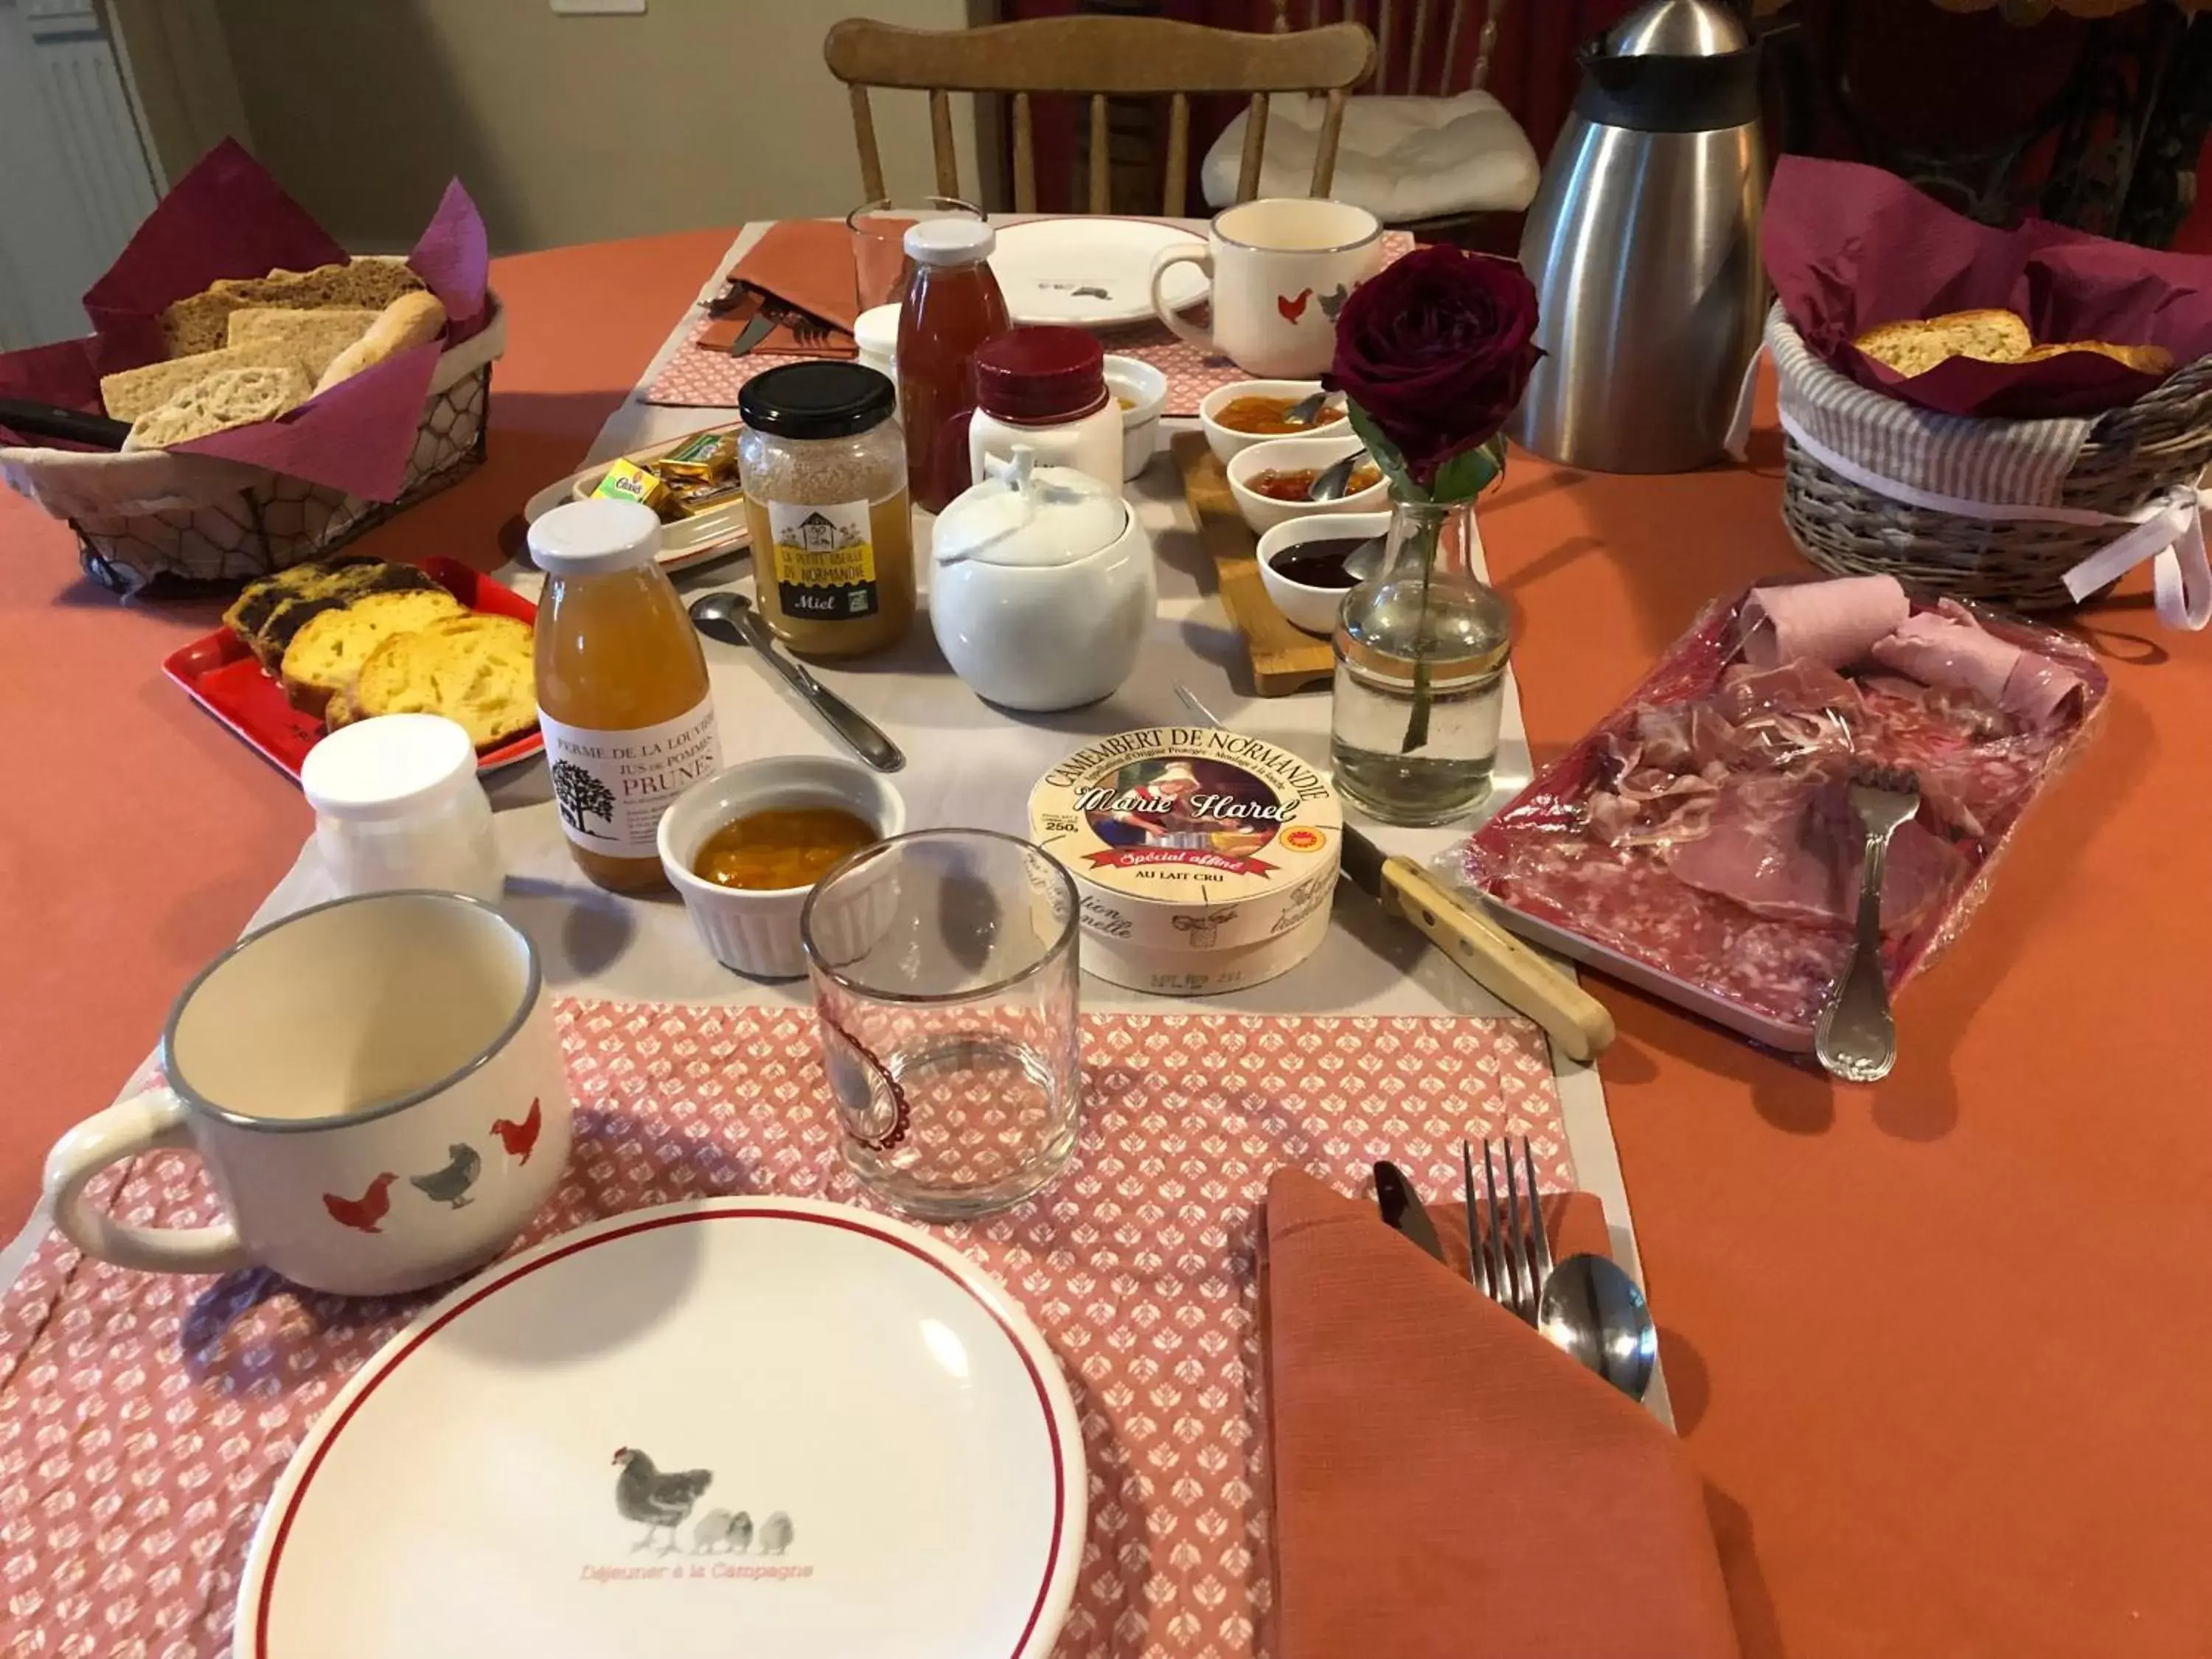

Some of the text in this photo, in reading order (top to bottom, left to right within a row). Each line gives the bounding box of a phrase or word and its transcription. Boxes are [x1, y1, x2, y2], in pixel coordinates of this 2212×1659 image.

[801, 566, 864, 582] NORMANDIE
[794, 595, 836, 611] Miel
[557, 738, 604, 759] FERME
[613, 748, 636, 759] DE
[642, 743, 661, 757] LA
[1045, 729, 1329, 801] CAMEMBERT DE NORMANDIE
[1074, 784, 1301, 824] Marie Harel
[1119, 852, 1245, 870] Spécial affiné
[1135, 871, 1224, 882] AU LAIT CRU
[1080, 914, 1133, 939] nelle
[711, 1561, 814, 1582] Campagne
